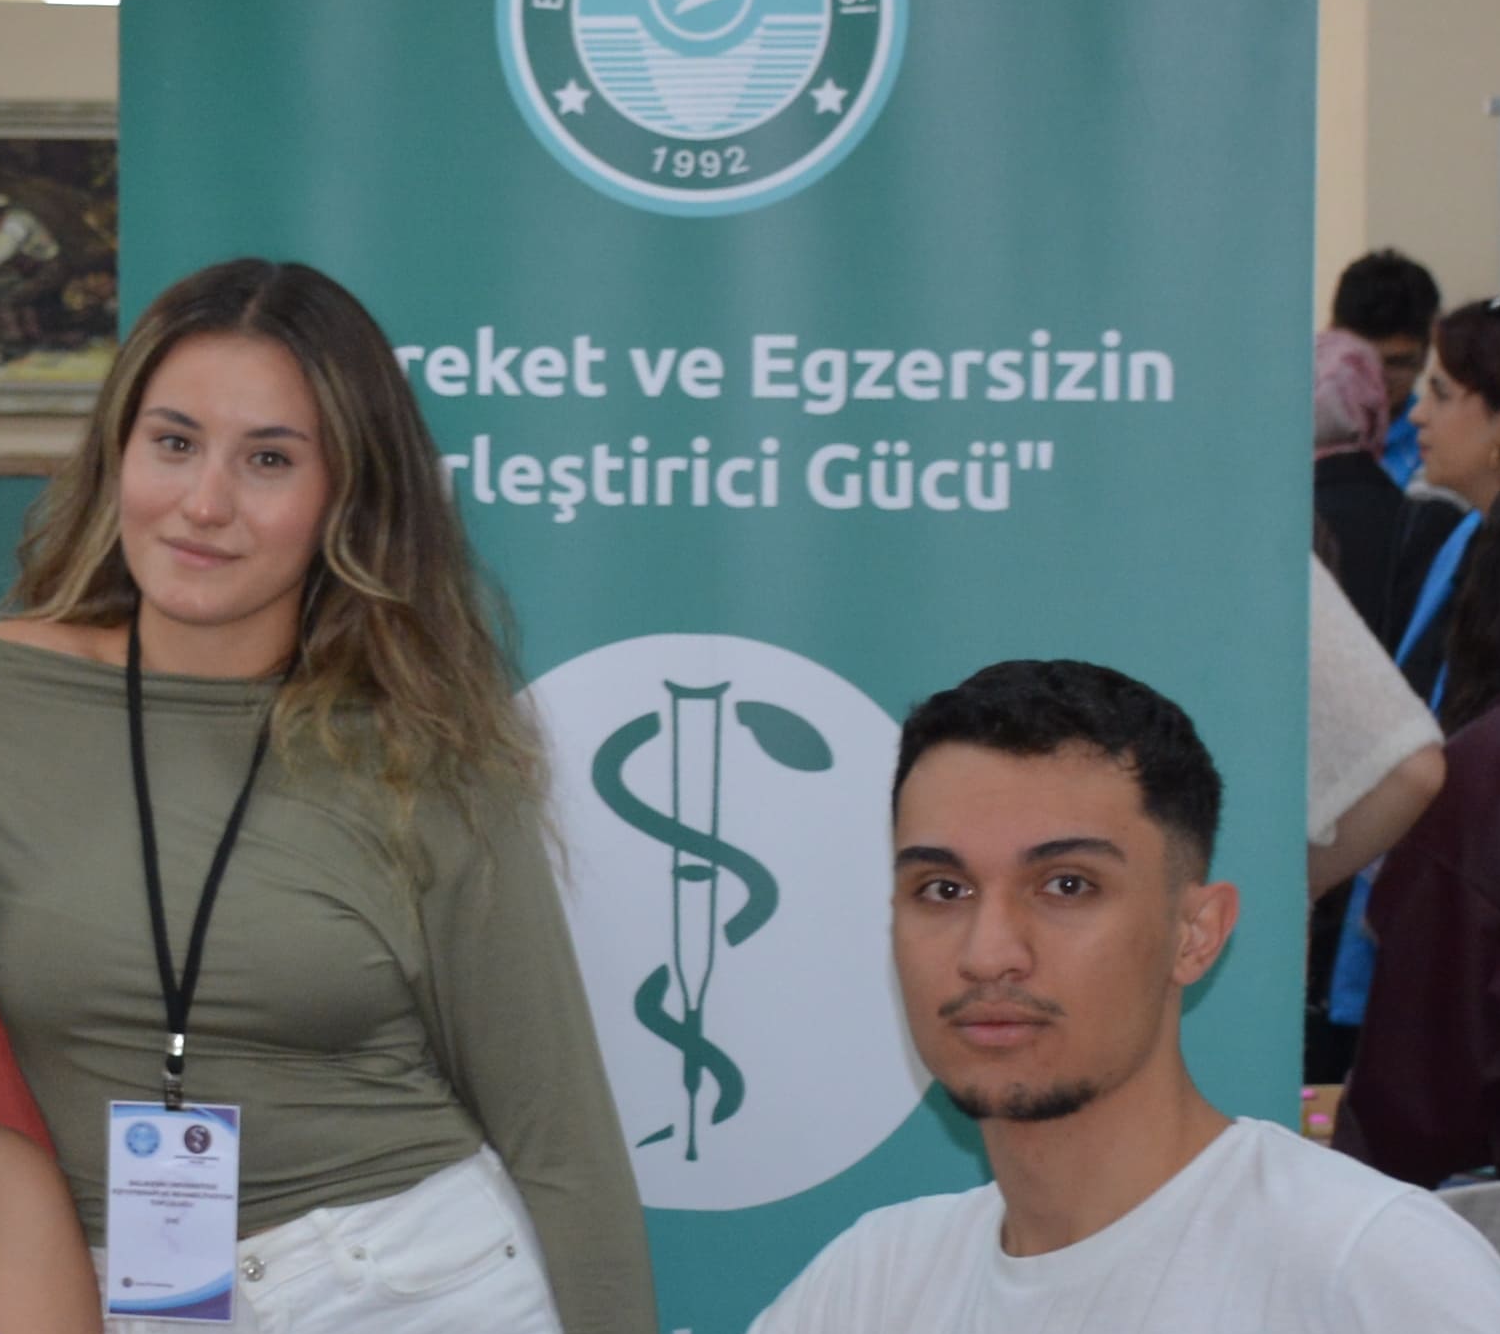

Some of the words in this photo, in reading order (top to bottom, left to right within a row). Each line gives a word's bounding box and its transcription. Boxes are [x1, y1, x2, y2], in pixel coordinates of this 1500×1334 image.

[652, 146, 750, 178] 1992
[396, 327, 606, 398] reket
[629, 348, 724, 399] ve
[751, 329, 1175, 415] Egzersizin
[440, 434, 780, 523] rleştirici
[807, 441, 1054, 512] Gücü"
